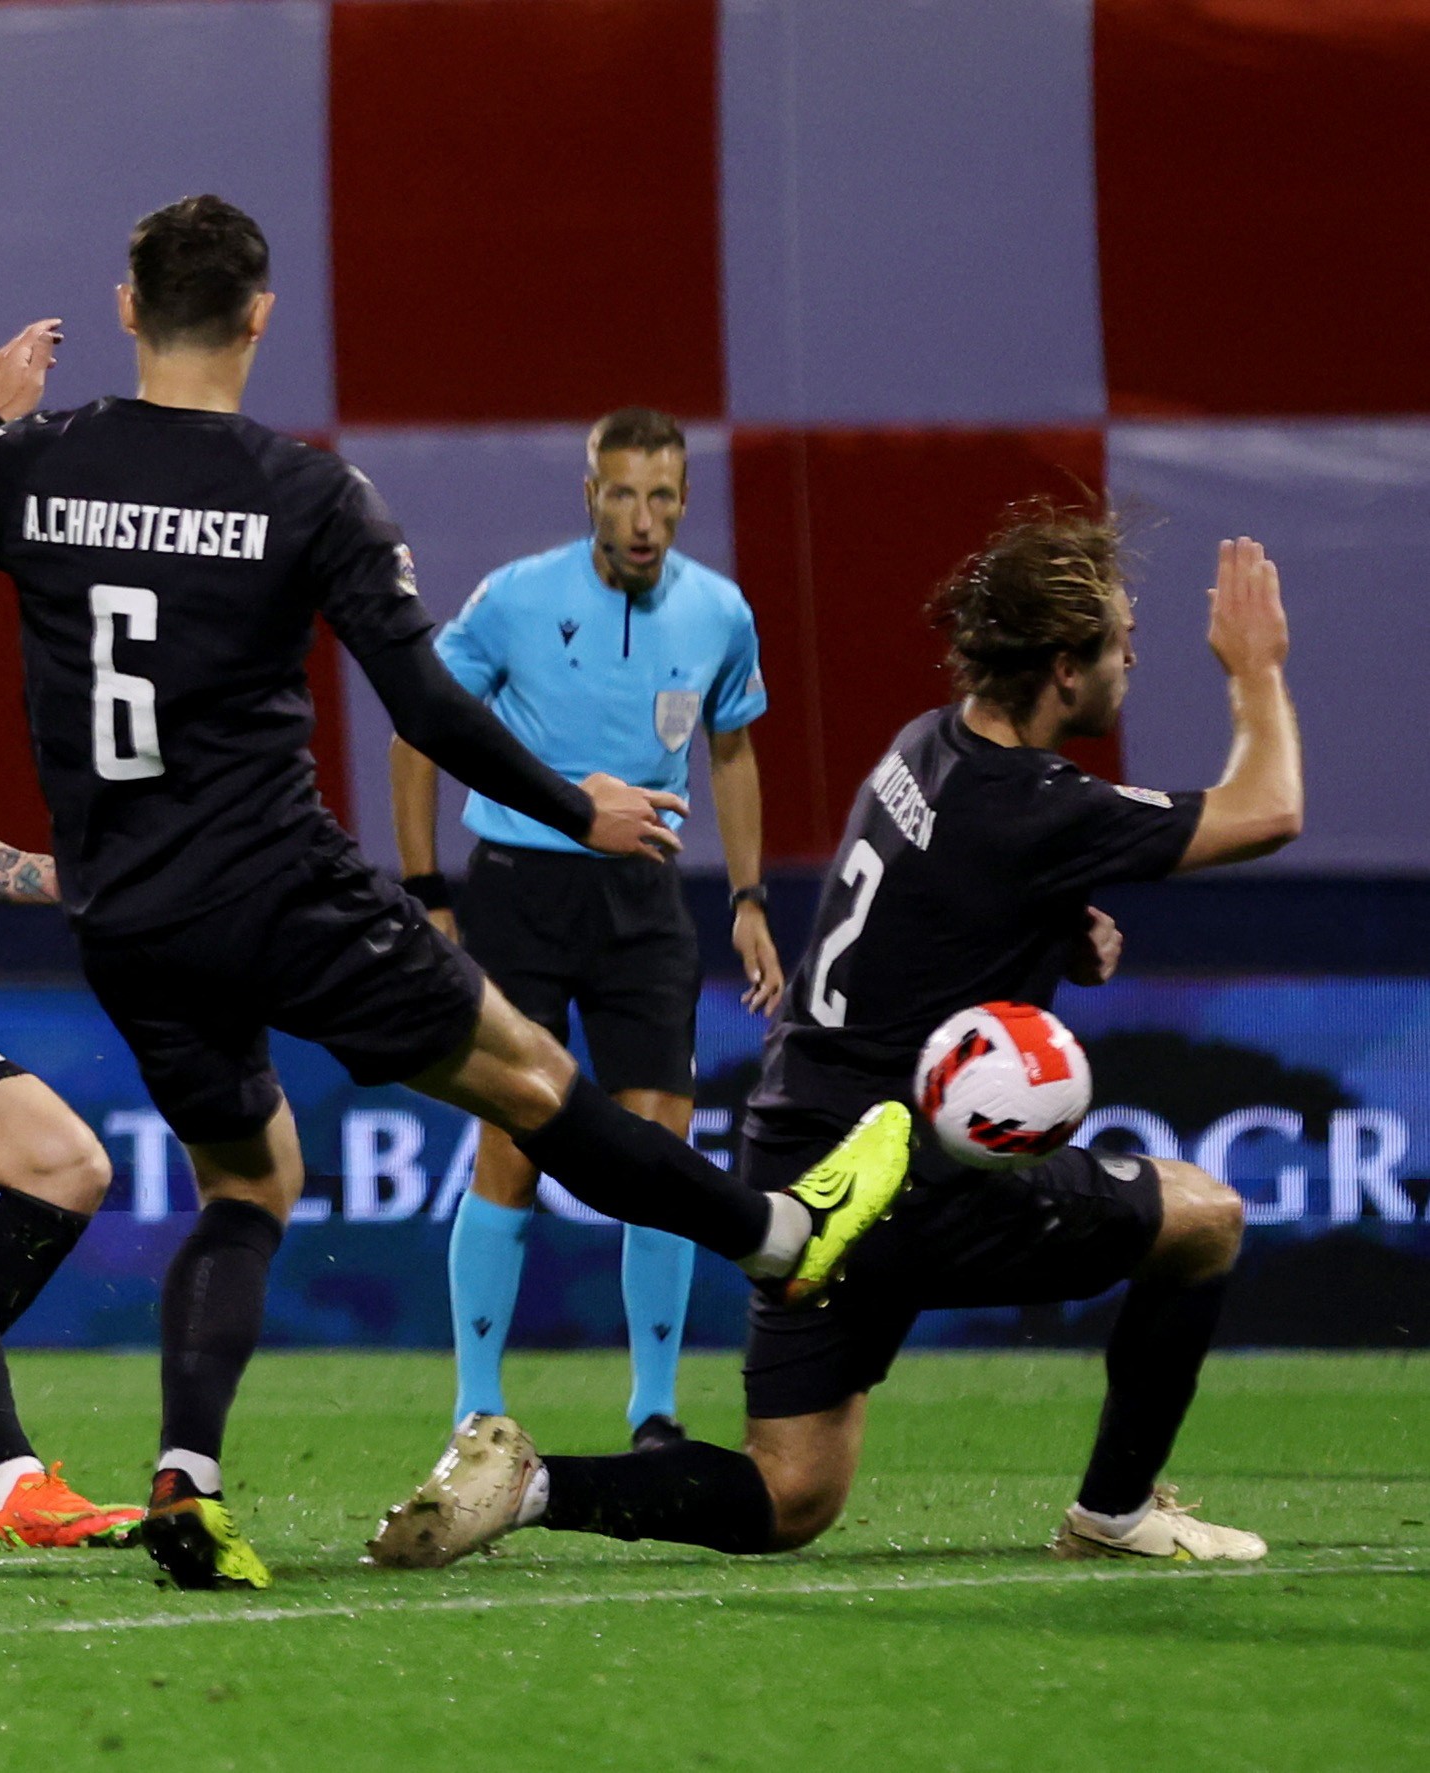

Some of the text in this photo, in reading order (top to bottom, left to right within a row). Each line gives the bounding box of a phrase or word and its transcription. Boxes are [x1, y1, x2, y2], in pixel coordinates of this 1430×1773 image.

[23, 494, 269, 560] A.CHRISTENSEN
[89, 584, 165, 780] 6
[808, 838, 884, 1028] 2
